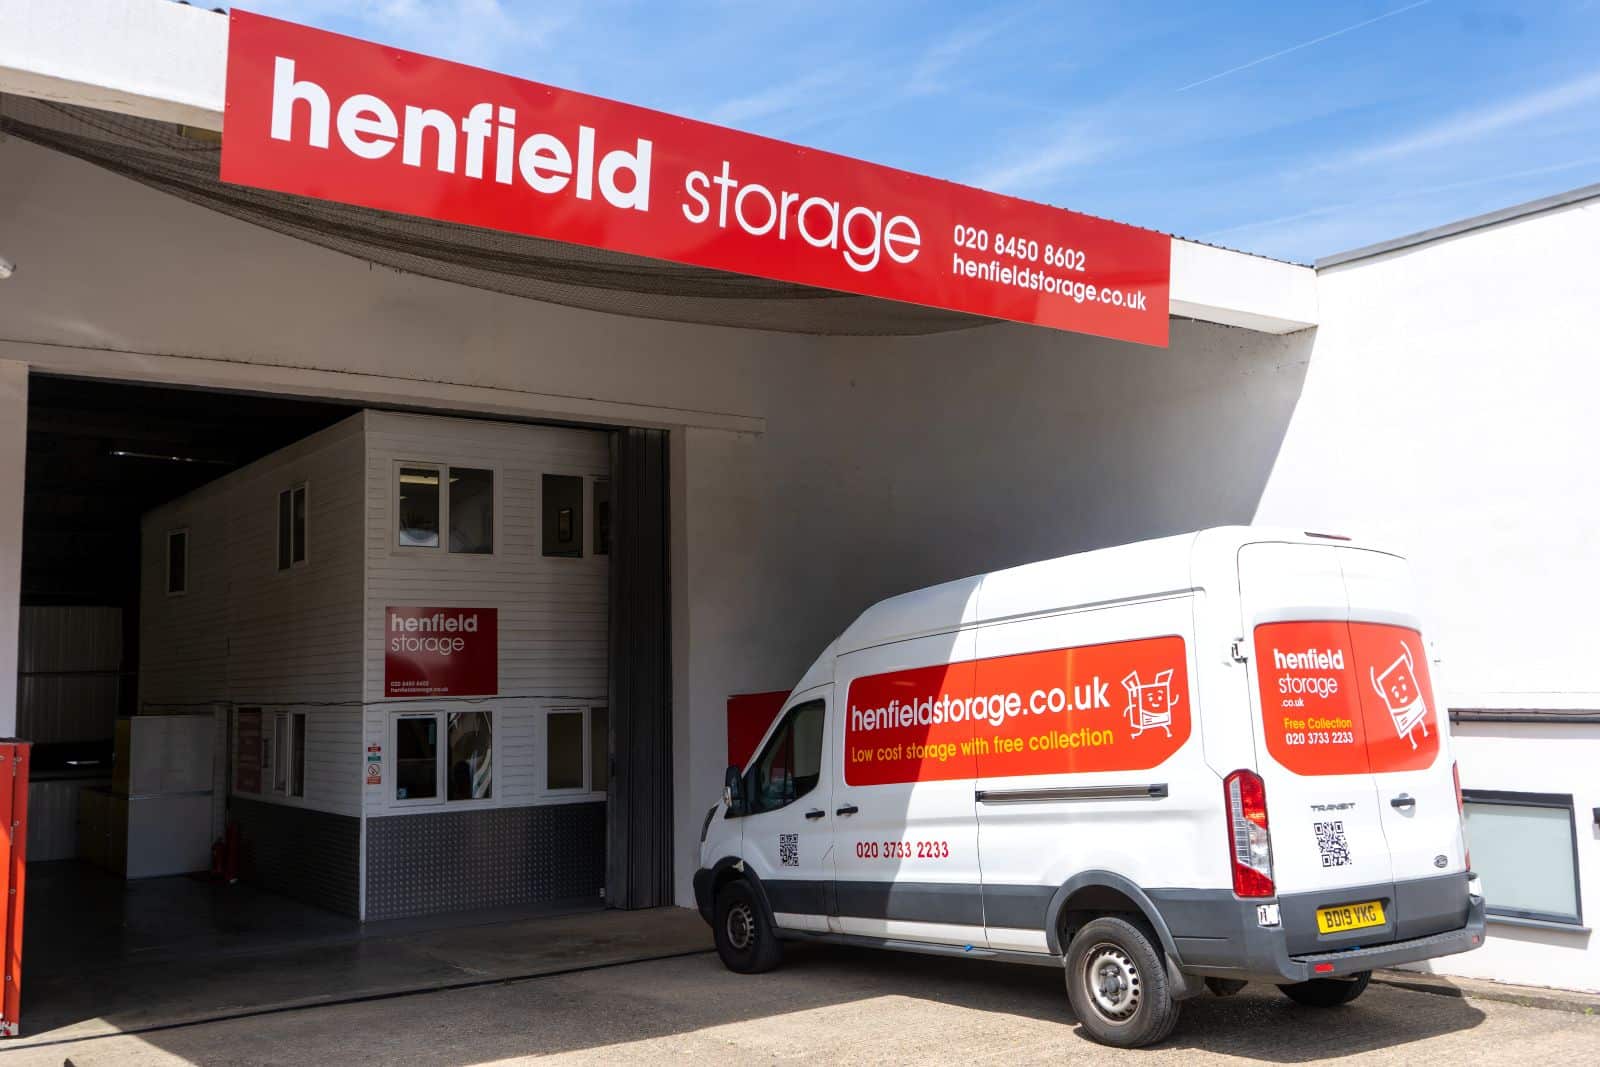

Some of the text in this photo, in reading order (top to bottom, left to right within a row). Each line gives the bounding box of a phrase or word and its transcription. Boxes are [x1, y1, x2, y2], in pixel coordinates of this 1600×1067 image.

[270, 56, 922, 273] henfield storage
[953, 224, 1086, 272] 020 8450 8602
[952, 252, 1147, 311] henfieldstorage.co.uk
[391, 613, 478, 632] henfield
[391, 634, 465, 655] storage
[1273, 648, 1345, 670] henfield
[1278, 672, 1338, 698] storage
[851, 675, 1111, 732] henfieldstorage.co.uk
[1281, 697, 1305, 707] .co.uk
[1284, 716, 1353, 729] Free Collection
[851, 728, 1114, 763] Low cost storage with free collection
[1285, 731, 1354, 745] 020 3733 2233
[856, 841, 949, 858] 020 3733 2233
[1324, 904, 1377, 928] BD19 VKG
